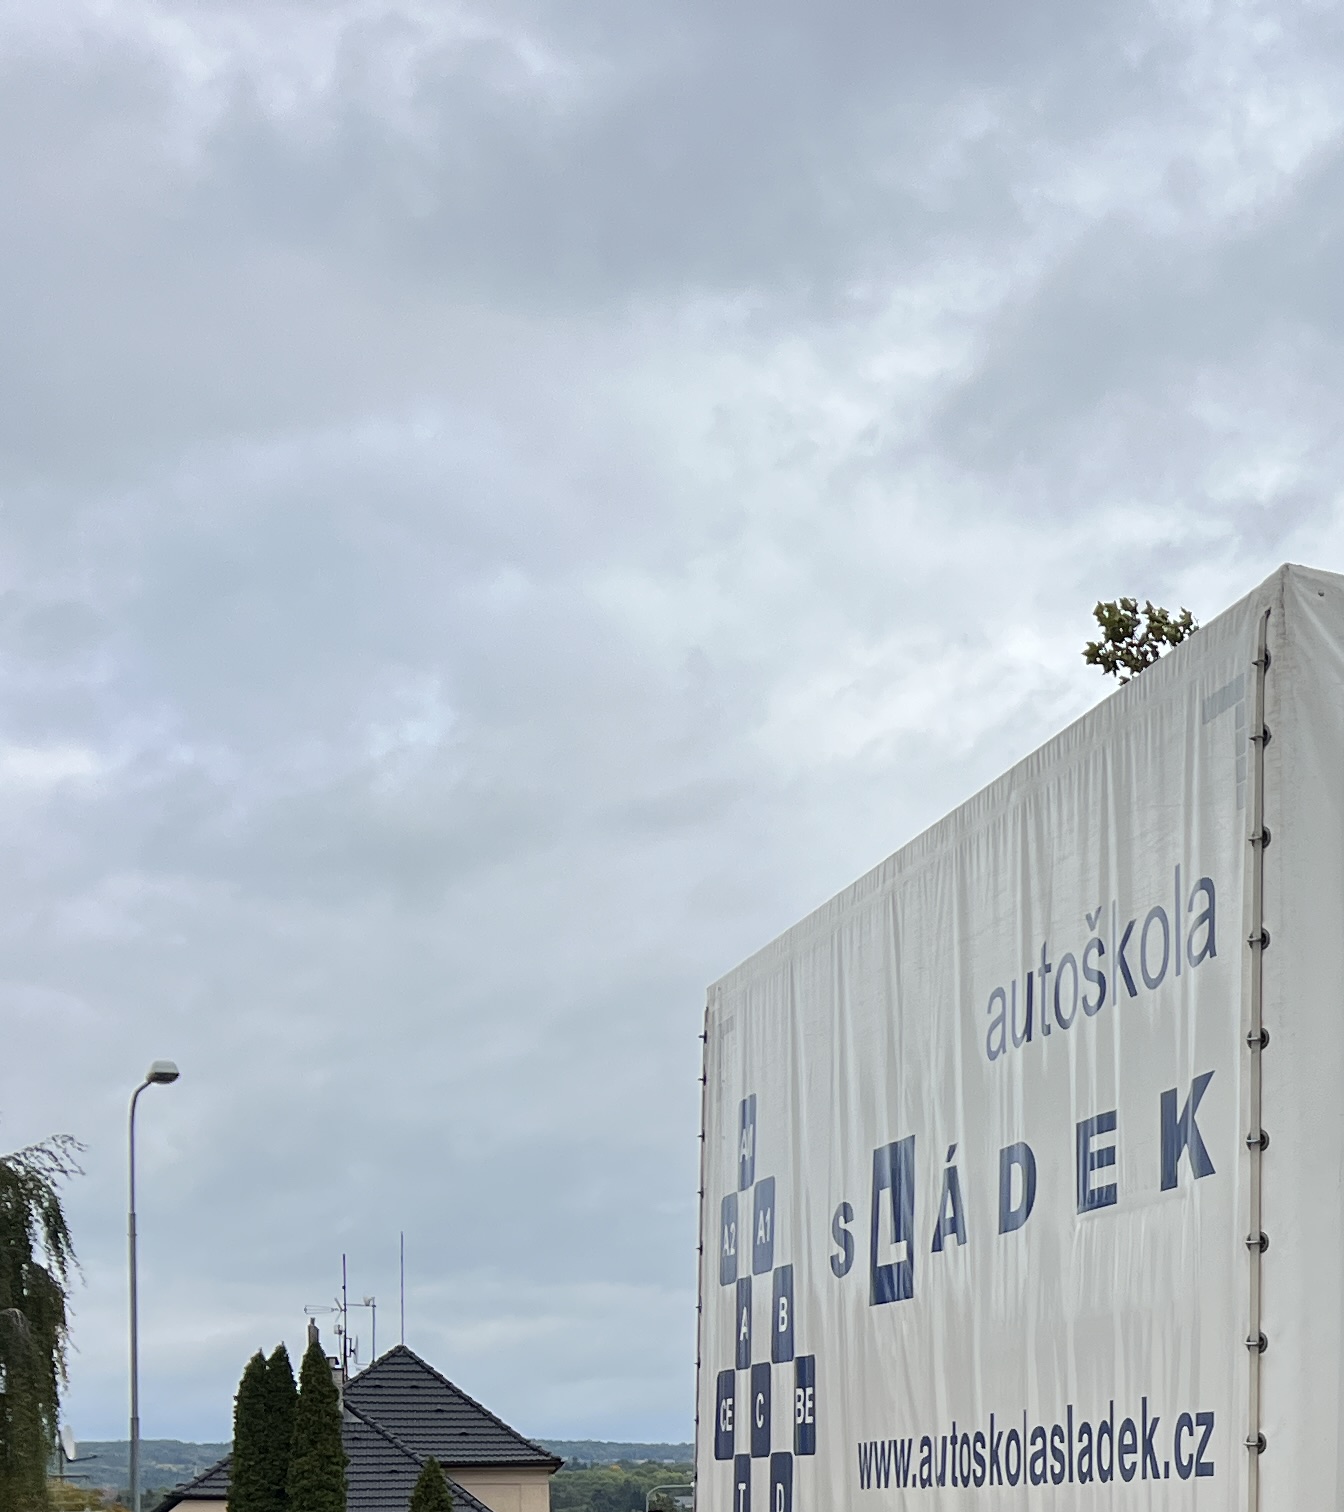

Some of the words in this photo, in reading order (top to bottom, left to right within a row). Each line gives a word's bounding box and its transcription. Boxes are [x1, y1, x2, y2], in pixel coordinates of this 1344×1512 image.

[986, 863, 1217, 1061] autoškola
[830, 1070, 1216, 1280] SLÁDEK
[724, 1222, 736, 1257] A2
[756, 1207, 771, 1245] A1
[739, 1305, 748, 1341] A
[778, 1296, 788, 1332] B
[719, 1397, 733, 1432] CE
[755, 1392, 764, 1429] C
[796, 1386, 814, 1425] BE
[857, 1396, 1215, 1490] www.autoskolasladek.cz
